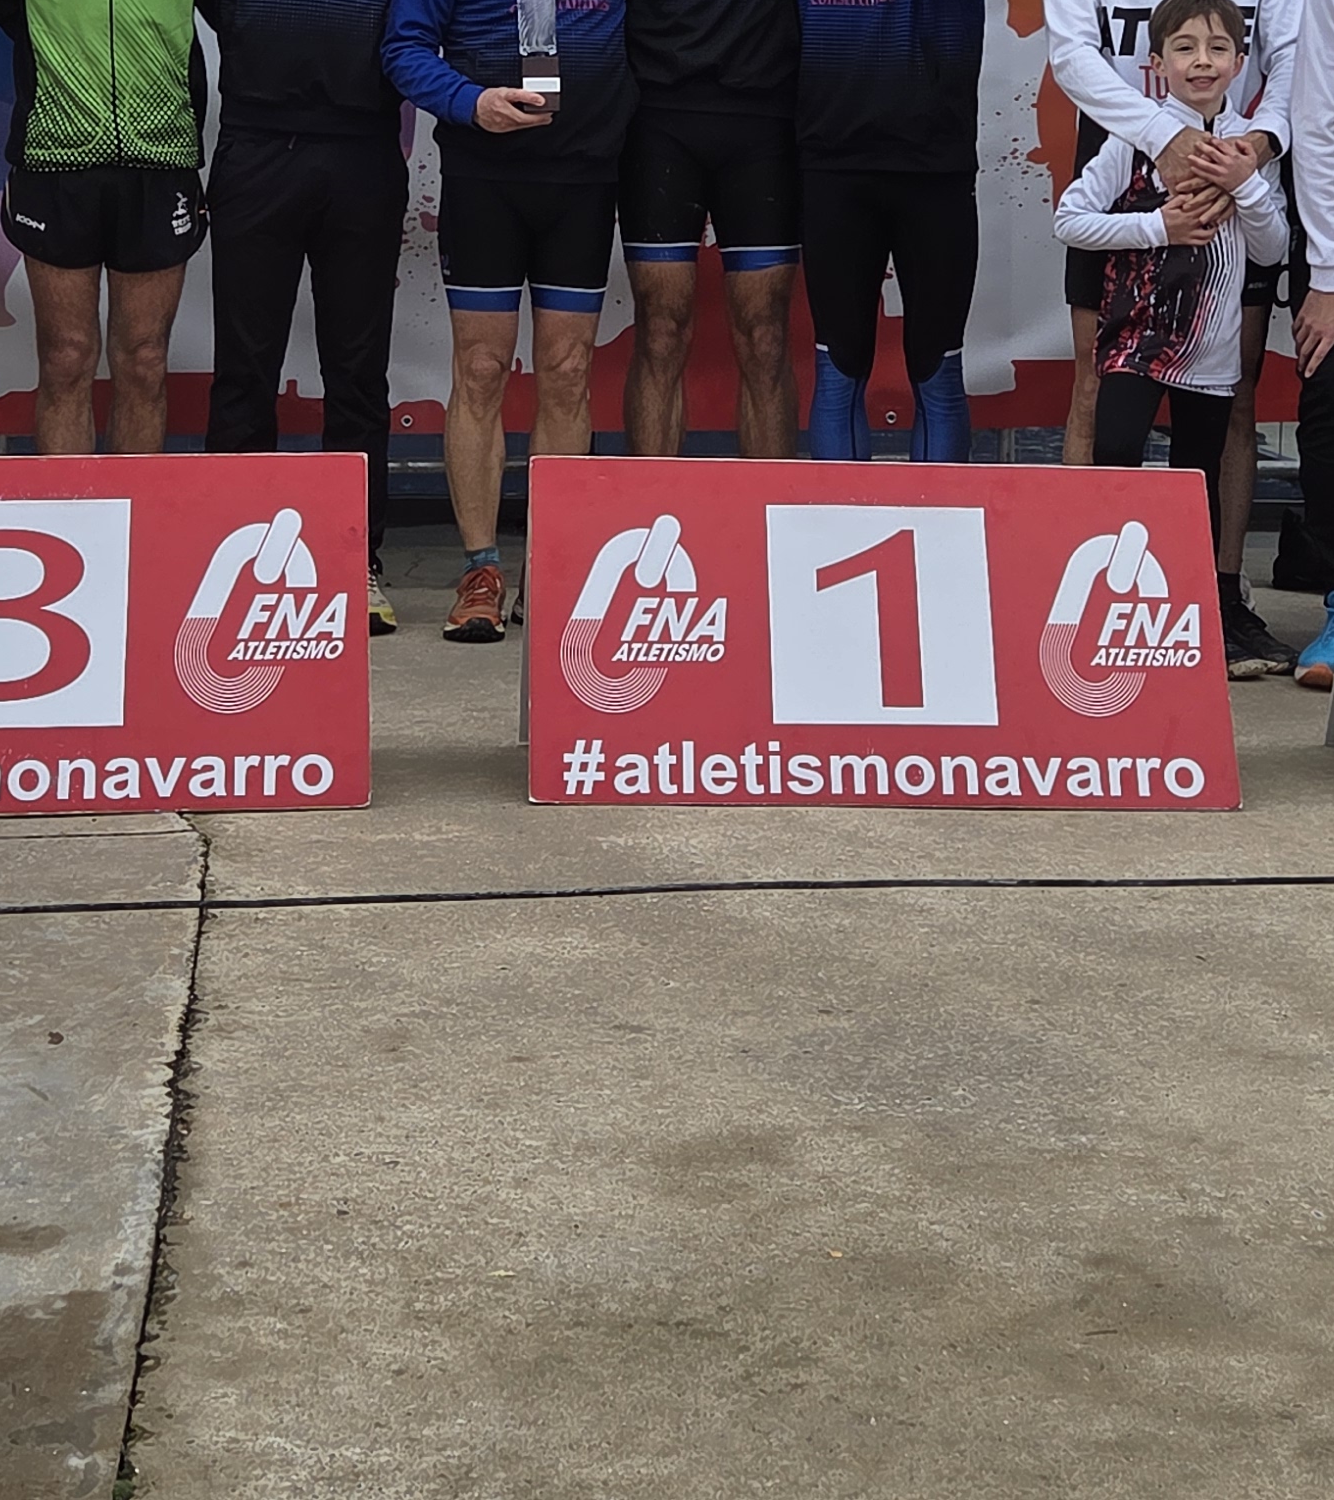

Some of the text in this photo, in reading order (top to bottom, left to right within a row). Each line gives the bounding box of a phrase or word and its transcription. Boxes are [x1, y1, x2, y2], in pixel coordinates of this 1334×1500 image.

[237, 593, 349, 640] FNA
[620, 597, 728, 643] FNA
[815, 528, 925, 709] 1
[1097, 602, 1202, 648] FNA
[227, 638, 345, 663] ATLETISMO
[611, 641, 726, 665] ATLETISMO
[1090, 646, 1202, 670] ATLETISMO
[562, 738, 1205, 799] #atletismonavarro
